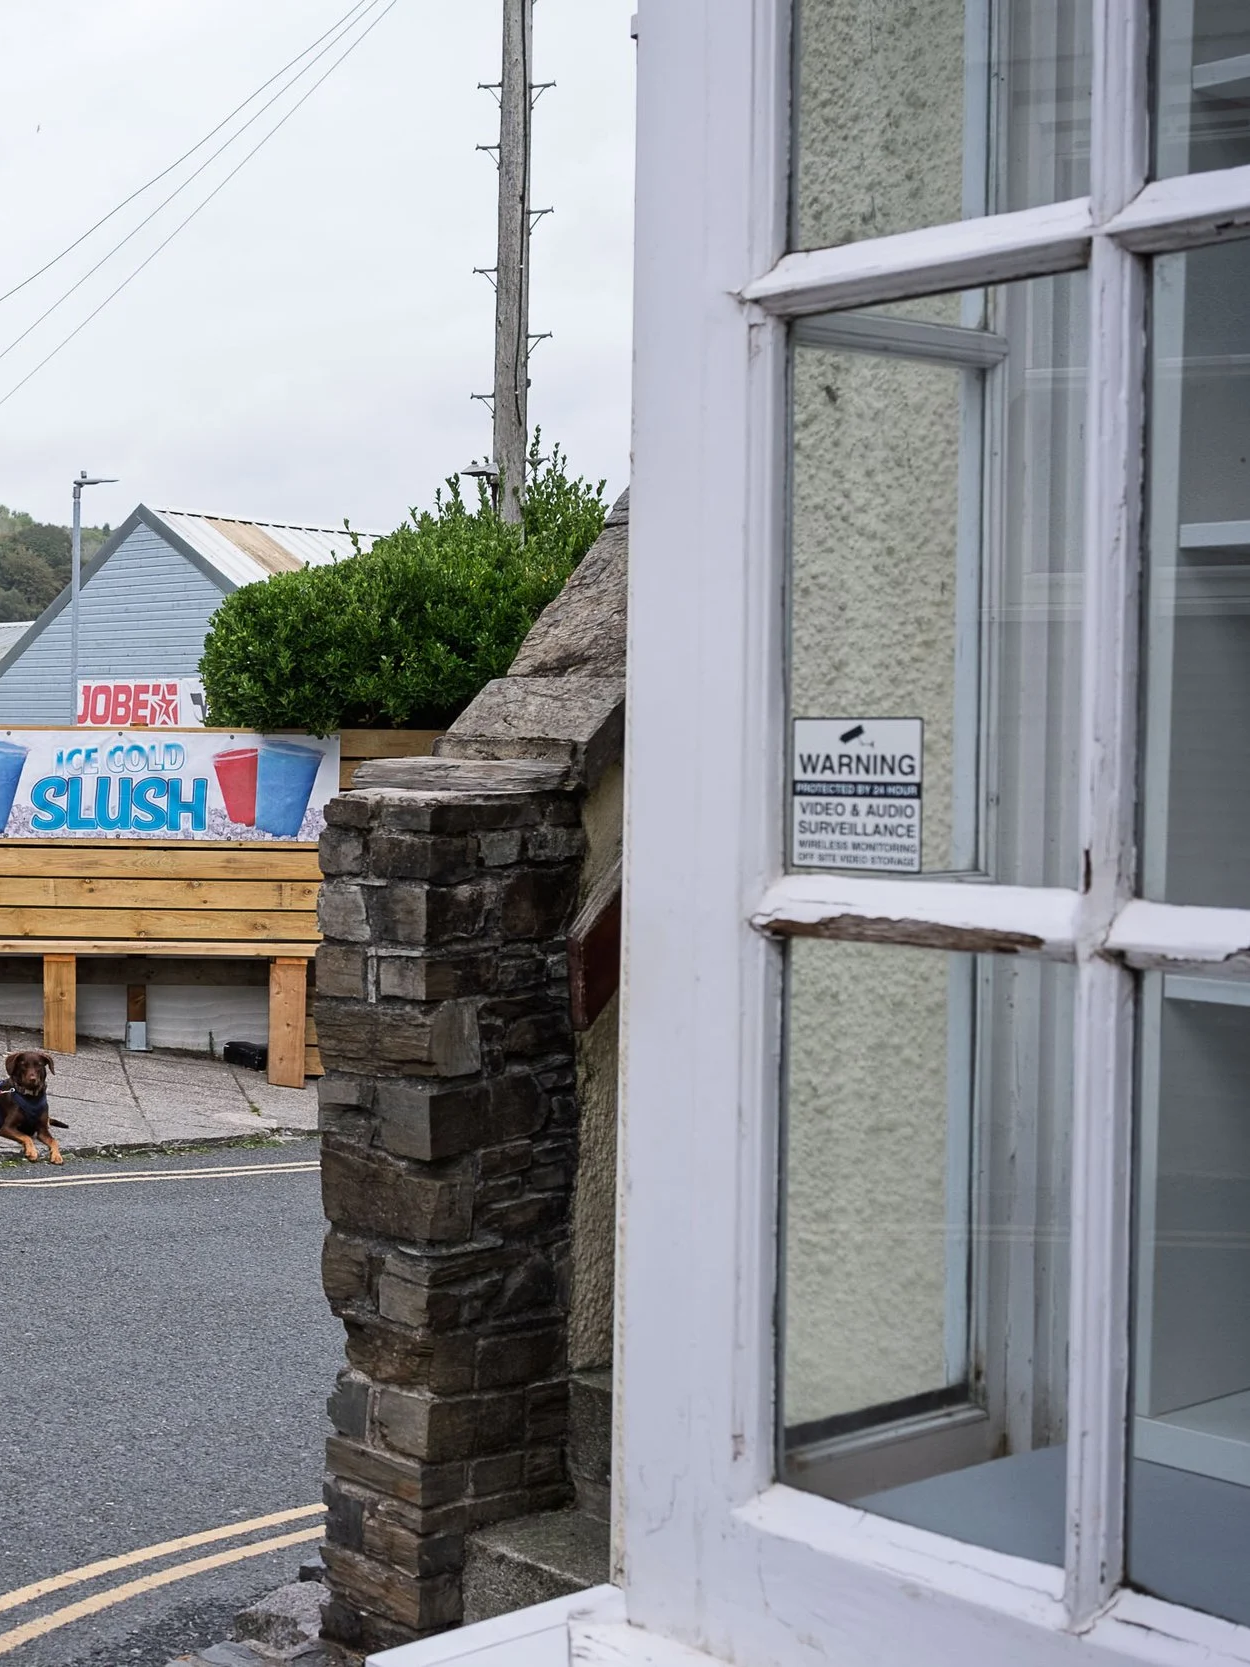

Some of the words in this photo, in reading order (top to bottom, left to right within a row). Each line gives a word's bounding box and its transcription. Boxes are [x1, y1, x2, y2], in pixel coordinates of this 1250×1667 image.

[54, 746, 99, 777] ICE
[106, 743, 186, 774] COLD
[799, 754, 916, 776] WARNING
[796, 783, 855, 795] PROTECTED
[856, 784, 871, 795] BY
[872, 785, 885, 796] 24
[886, 785, 918, 796] HOUR
[30, 776, 209, 831] SLUSH
[799, 802, 846, 817] VIDEO
[851, 803, 860, 817] &
[865, 804, 916, 819] AUDIO
[798, 820, 917, 839] SURVEILLANCE
[799, 840, 848, 851] WIRELESS
[852, 842, 918, 854] MONITORING
